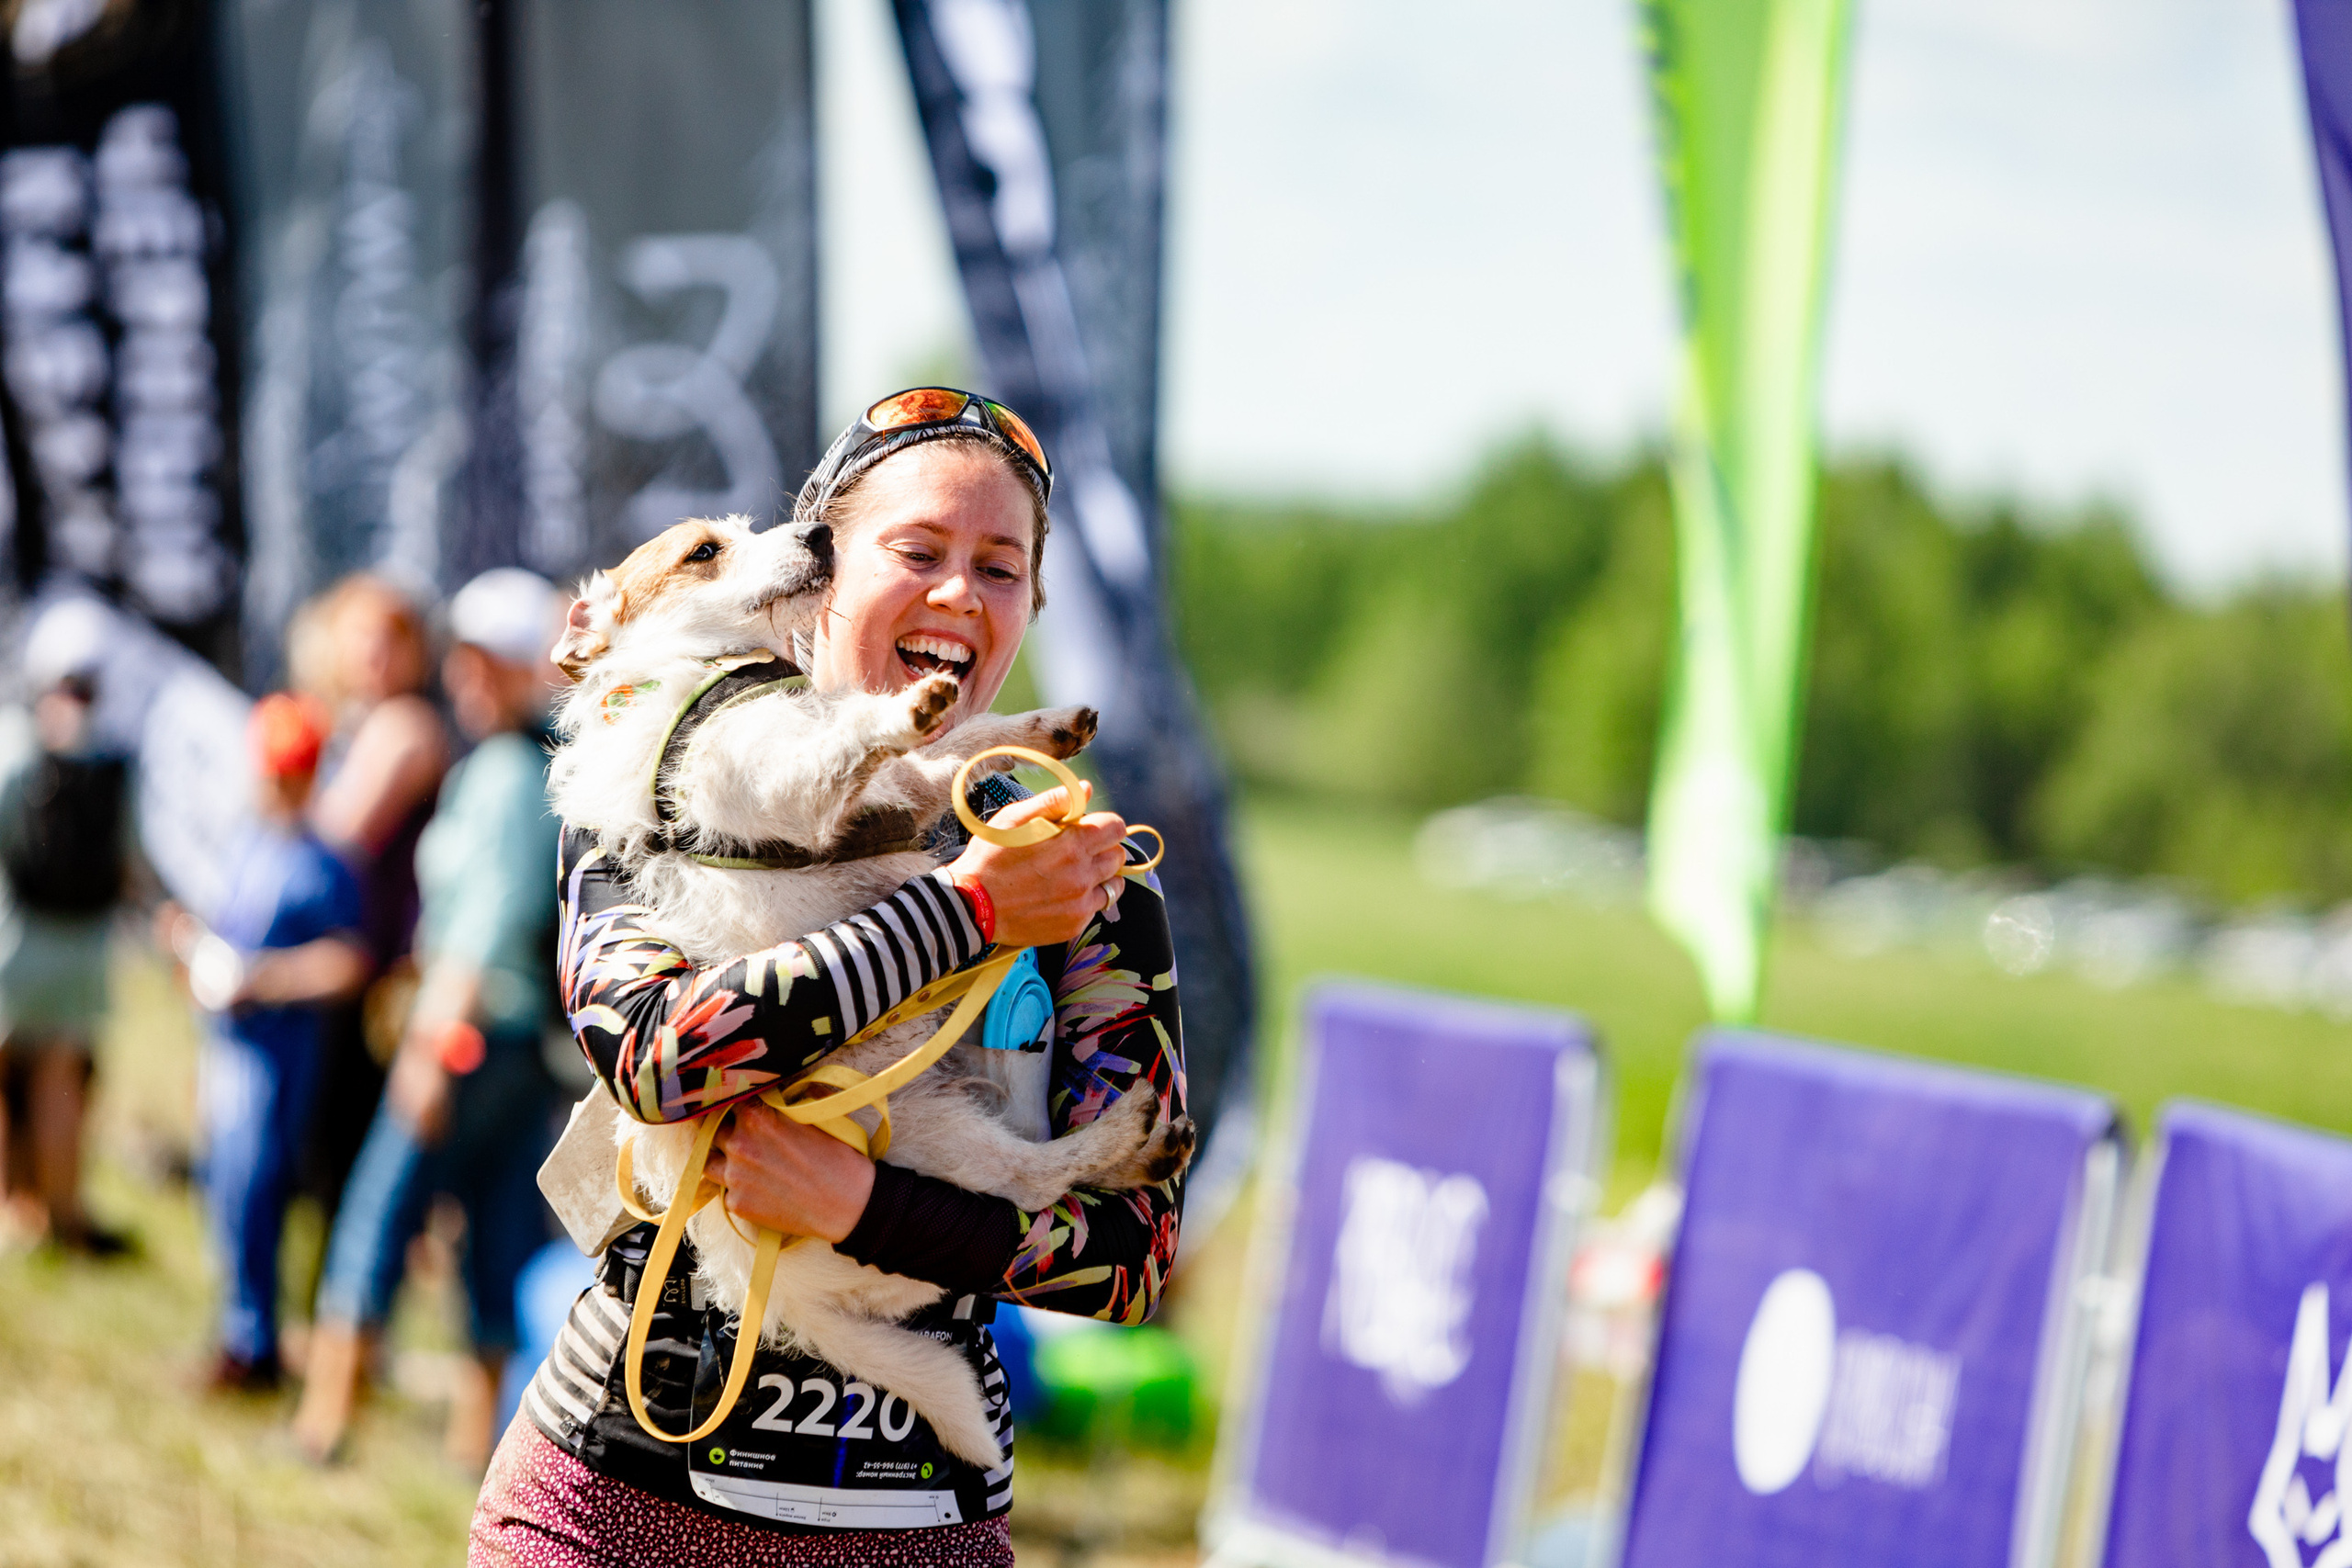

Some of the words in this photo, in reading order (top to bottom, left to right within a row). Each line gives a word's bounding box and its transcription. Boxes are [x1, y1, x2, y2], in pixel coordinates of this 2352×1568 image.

[915, 1329, 953, 1341] ARAFON
[752, 1373, 917, 1442] 2220
[729, 1449, 776, 1461] Финишное
[729, 1460, 764, 1470] питание
